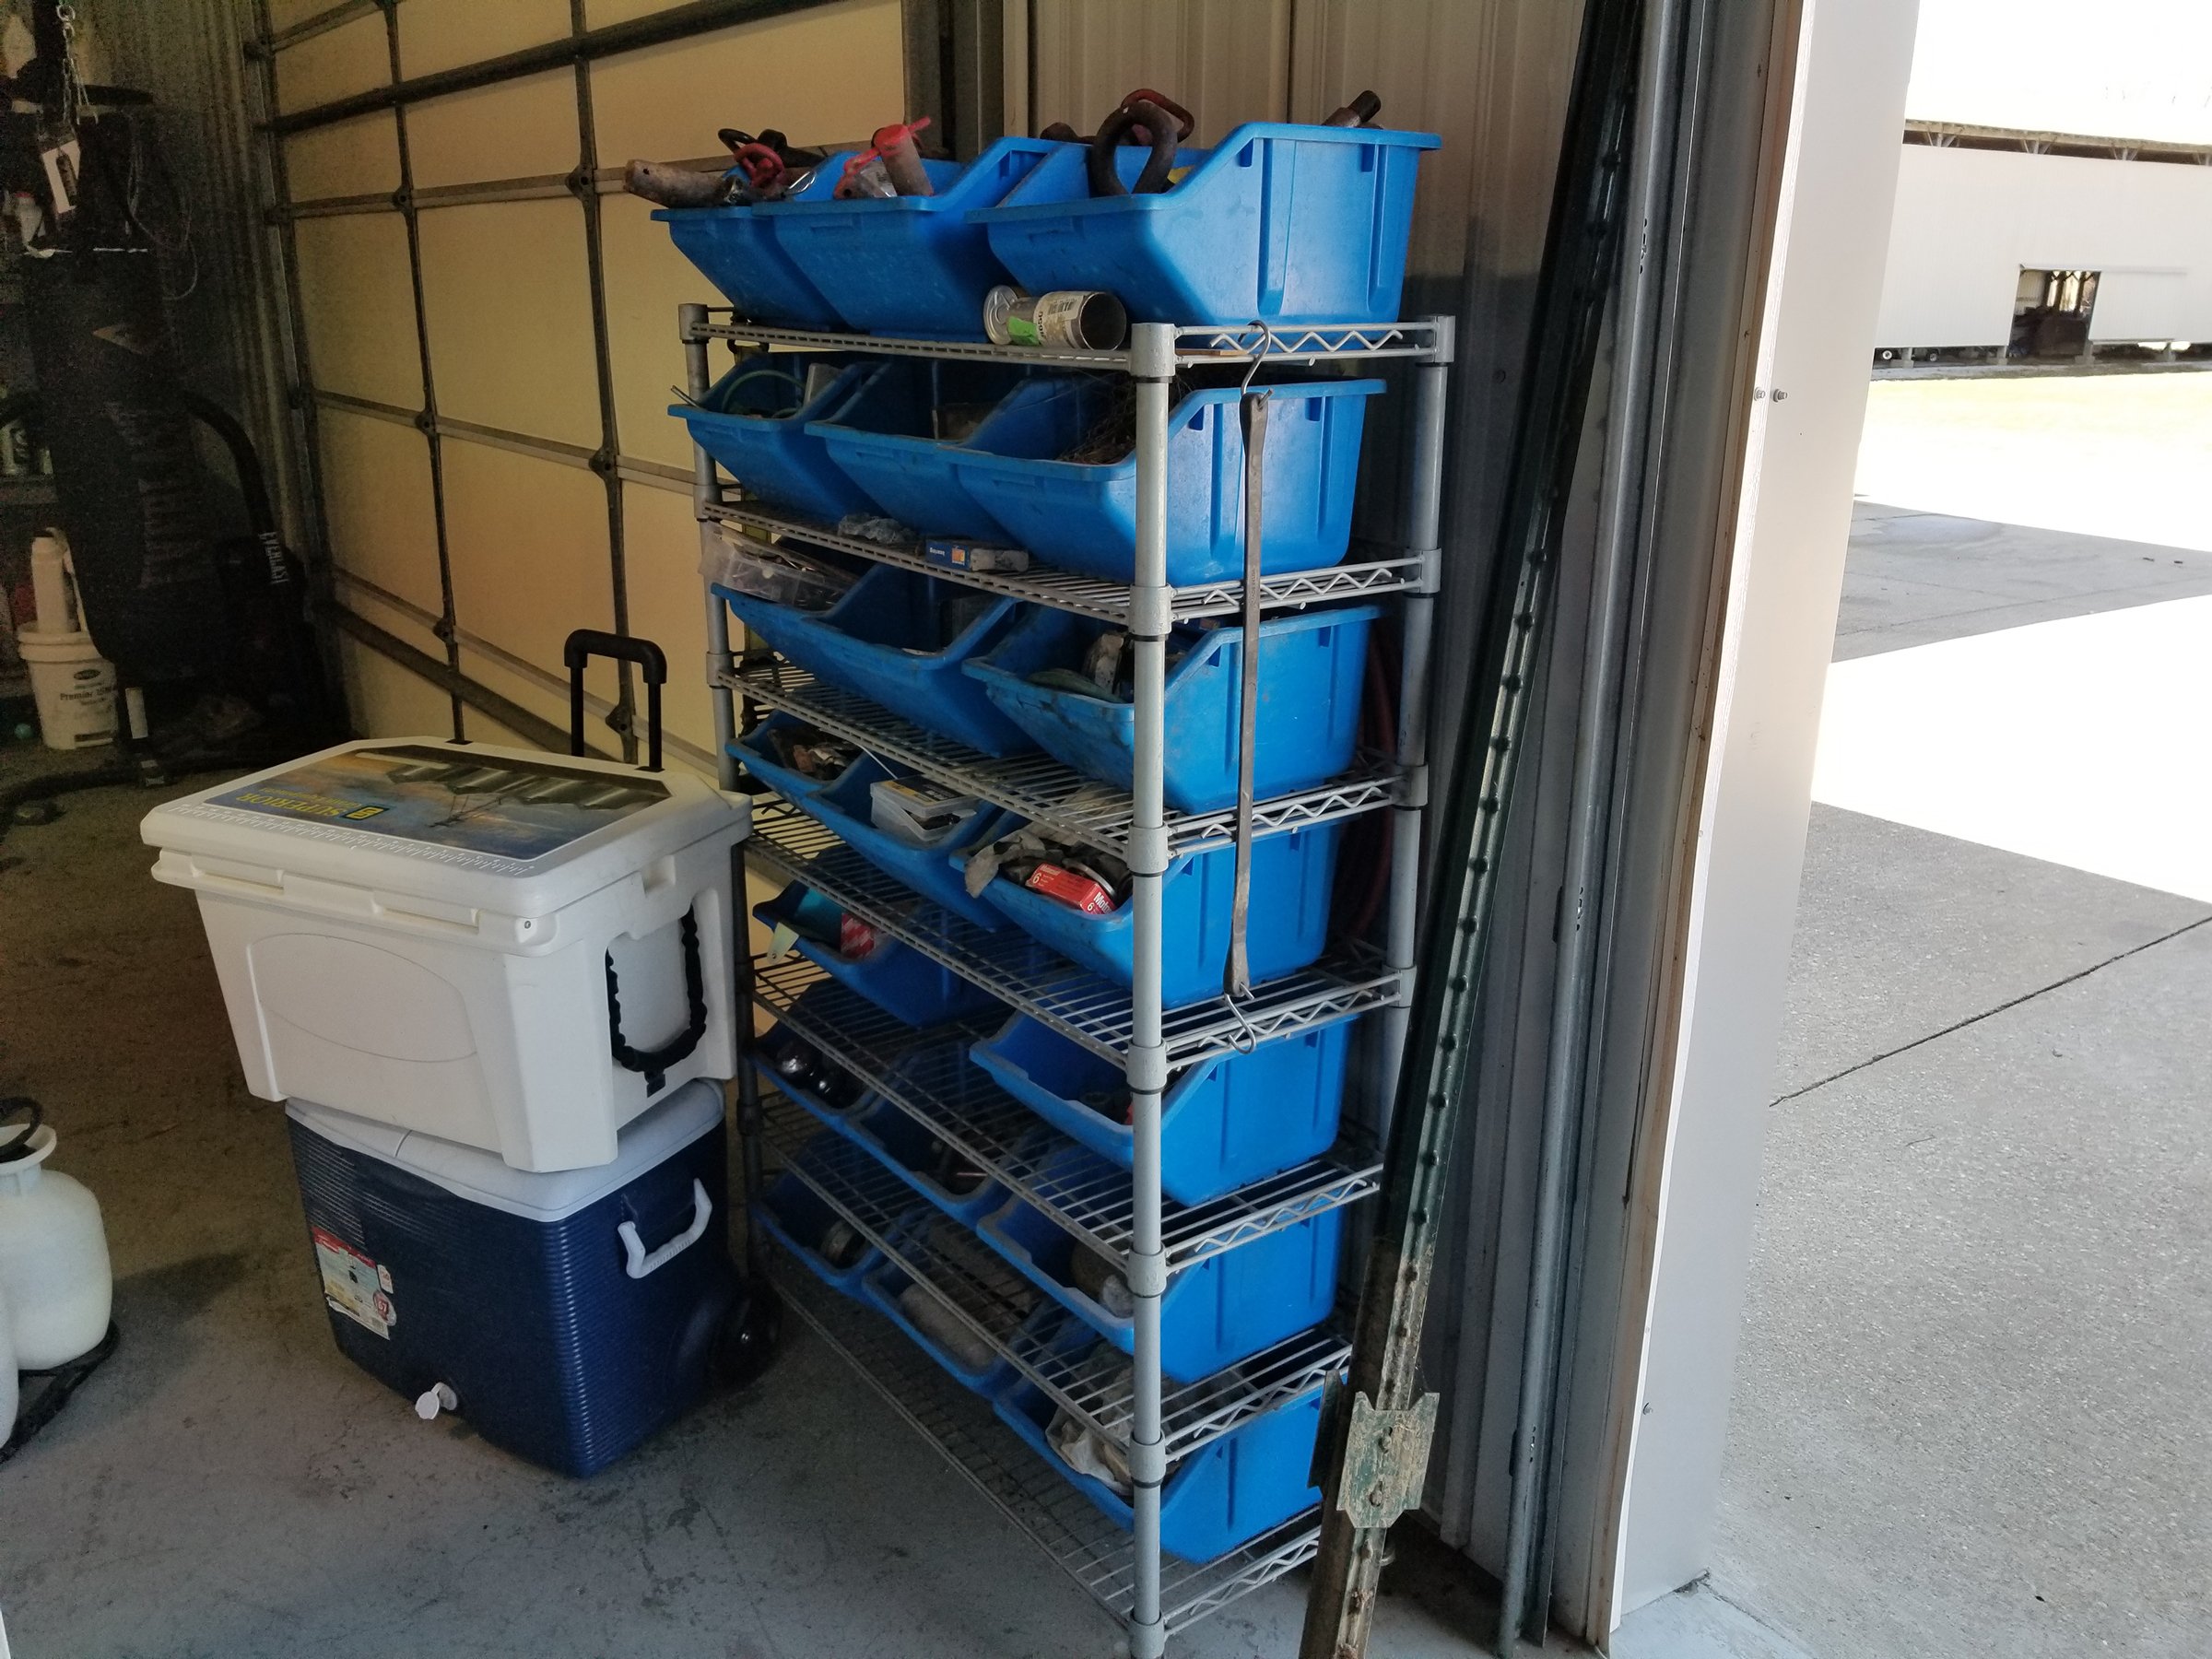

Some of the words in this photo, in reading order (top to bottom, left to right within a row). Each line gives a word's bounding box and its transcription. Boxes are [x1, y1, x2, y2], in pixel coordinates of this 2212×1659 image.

[236, 793, 345, 817] SUPERIOR
[1032, 873, 1041, 884] 6
[1087, 902, 1095, 912] 6
